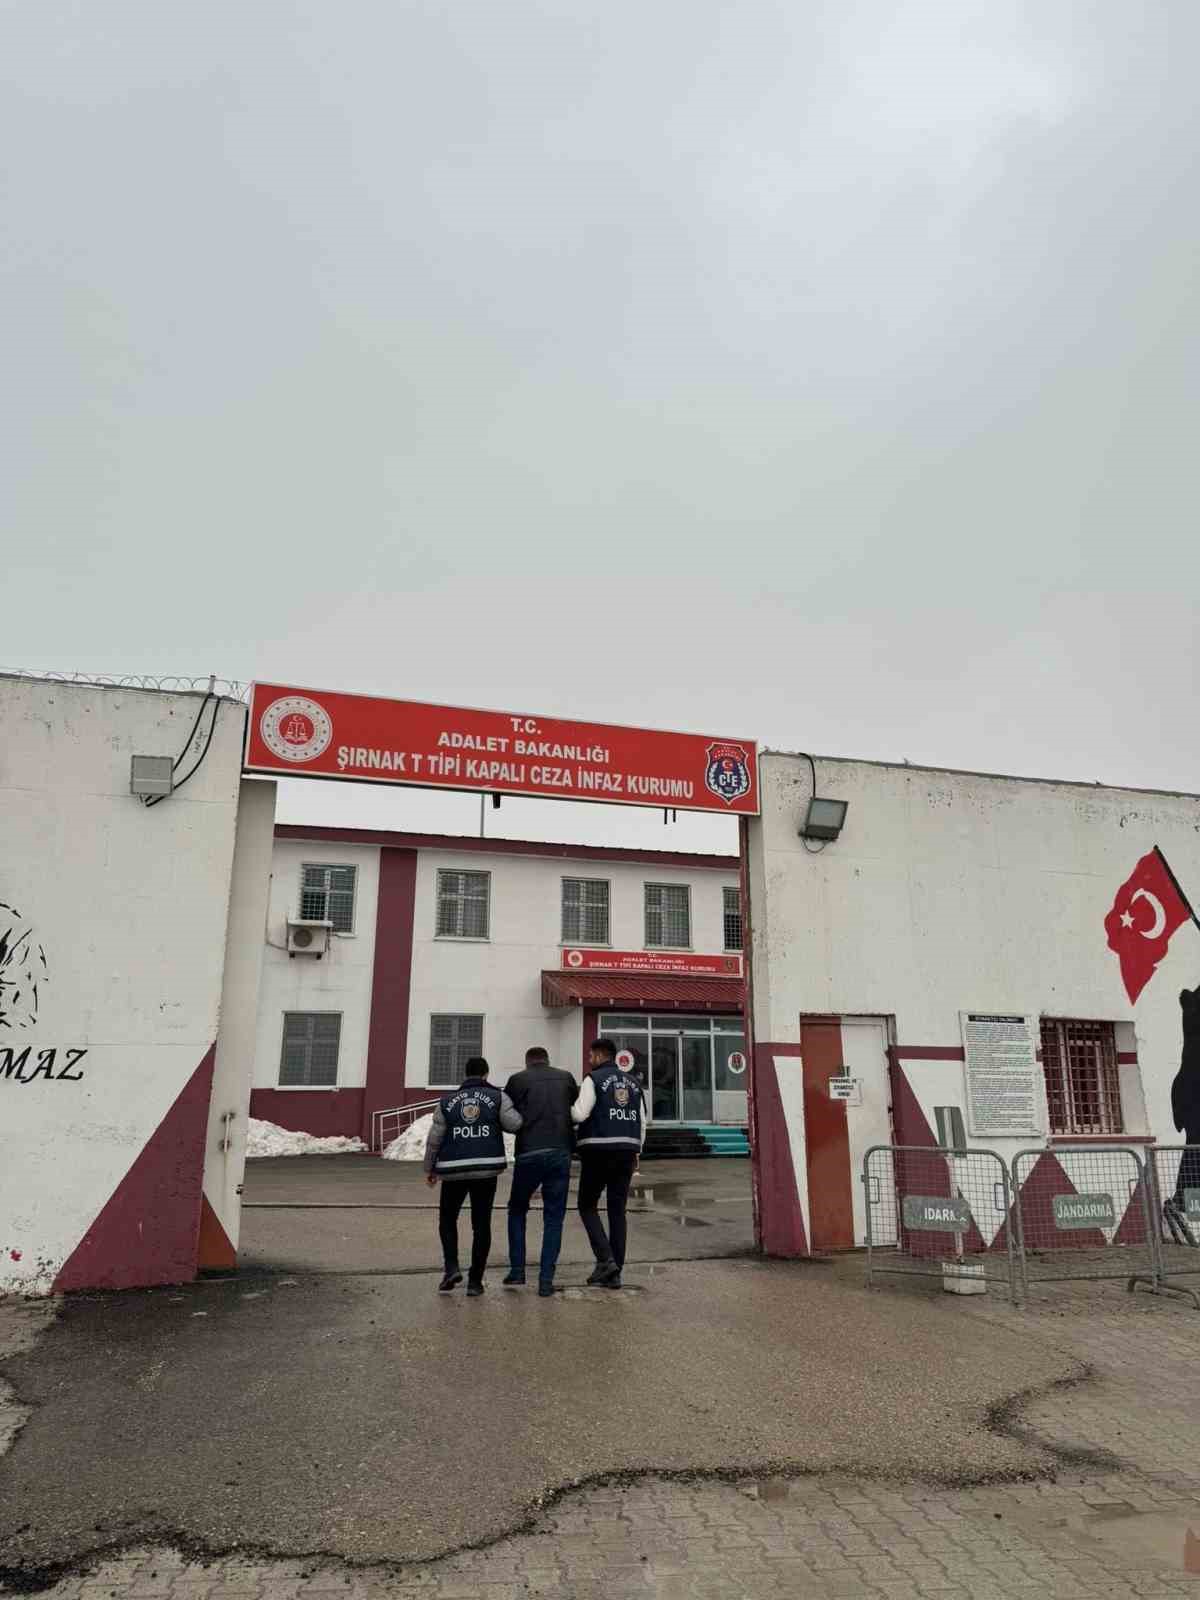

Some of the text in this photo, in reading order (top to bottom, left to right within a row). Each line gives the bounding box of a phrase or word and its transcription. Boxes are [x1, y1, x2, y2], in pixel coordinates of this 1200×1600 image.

[510, 718, 542, 735] T.C.
[437, 731, 610, 764] ADALET BAKANLIĞI
[337, 746, 694, 799] ŞIRNAK T TİPİ KAPALI CEZA İNFAZ KURUMU
[1057, 1203, 1113, 1218] JANDARMA
